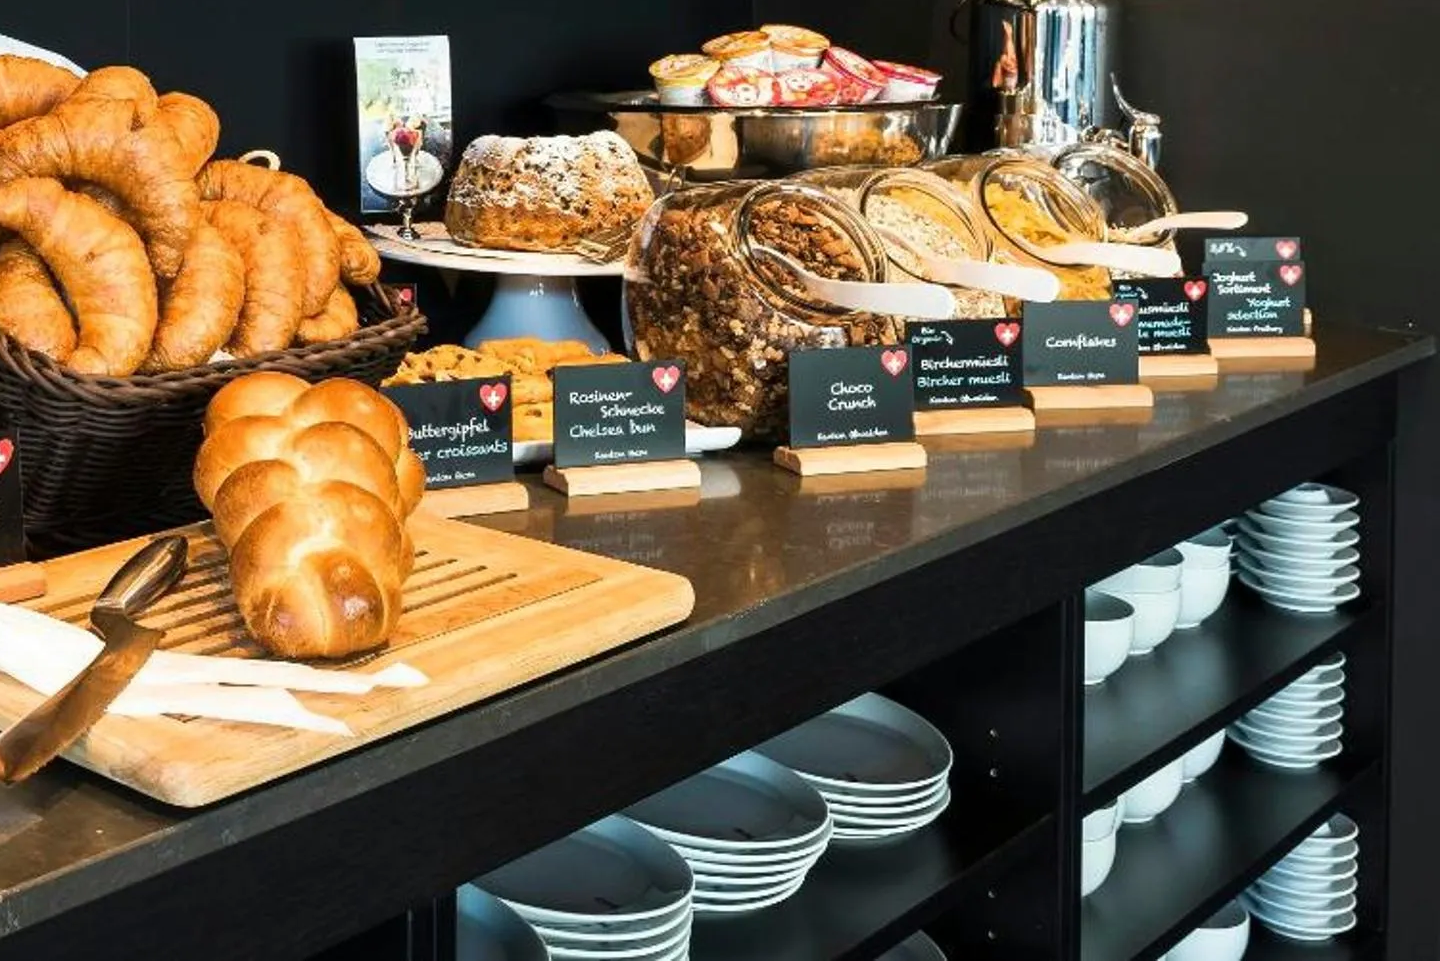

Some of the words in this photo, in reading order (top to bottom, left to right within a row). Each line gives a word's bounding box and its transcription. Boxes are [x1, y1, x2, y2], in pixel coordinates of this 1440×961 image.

[917, 374, 964, 388] Bircher
[968, 371, 1011, 386] muesli
[830, 380, 875, 396] Choco
[569, 390, 633, 405] Rosinen-
[826, 395, 877, 411] Crunch
[600, 402, 666, 419] Schnecke
[569, 422, 625, 438] Chelsea
[628, 419, 657, 435] bun
[436, 439, 508, 459] croissants
[425, 473, 453, 484] anton
